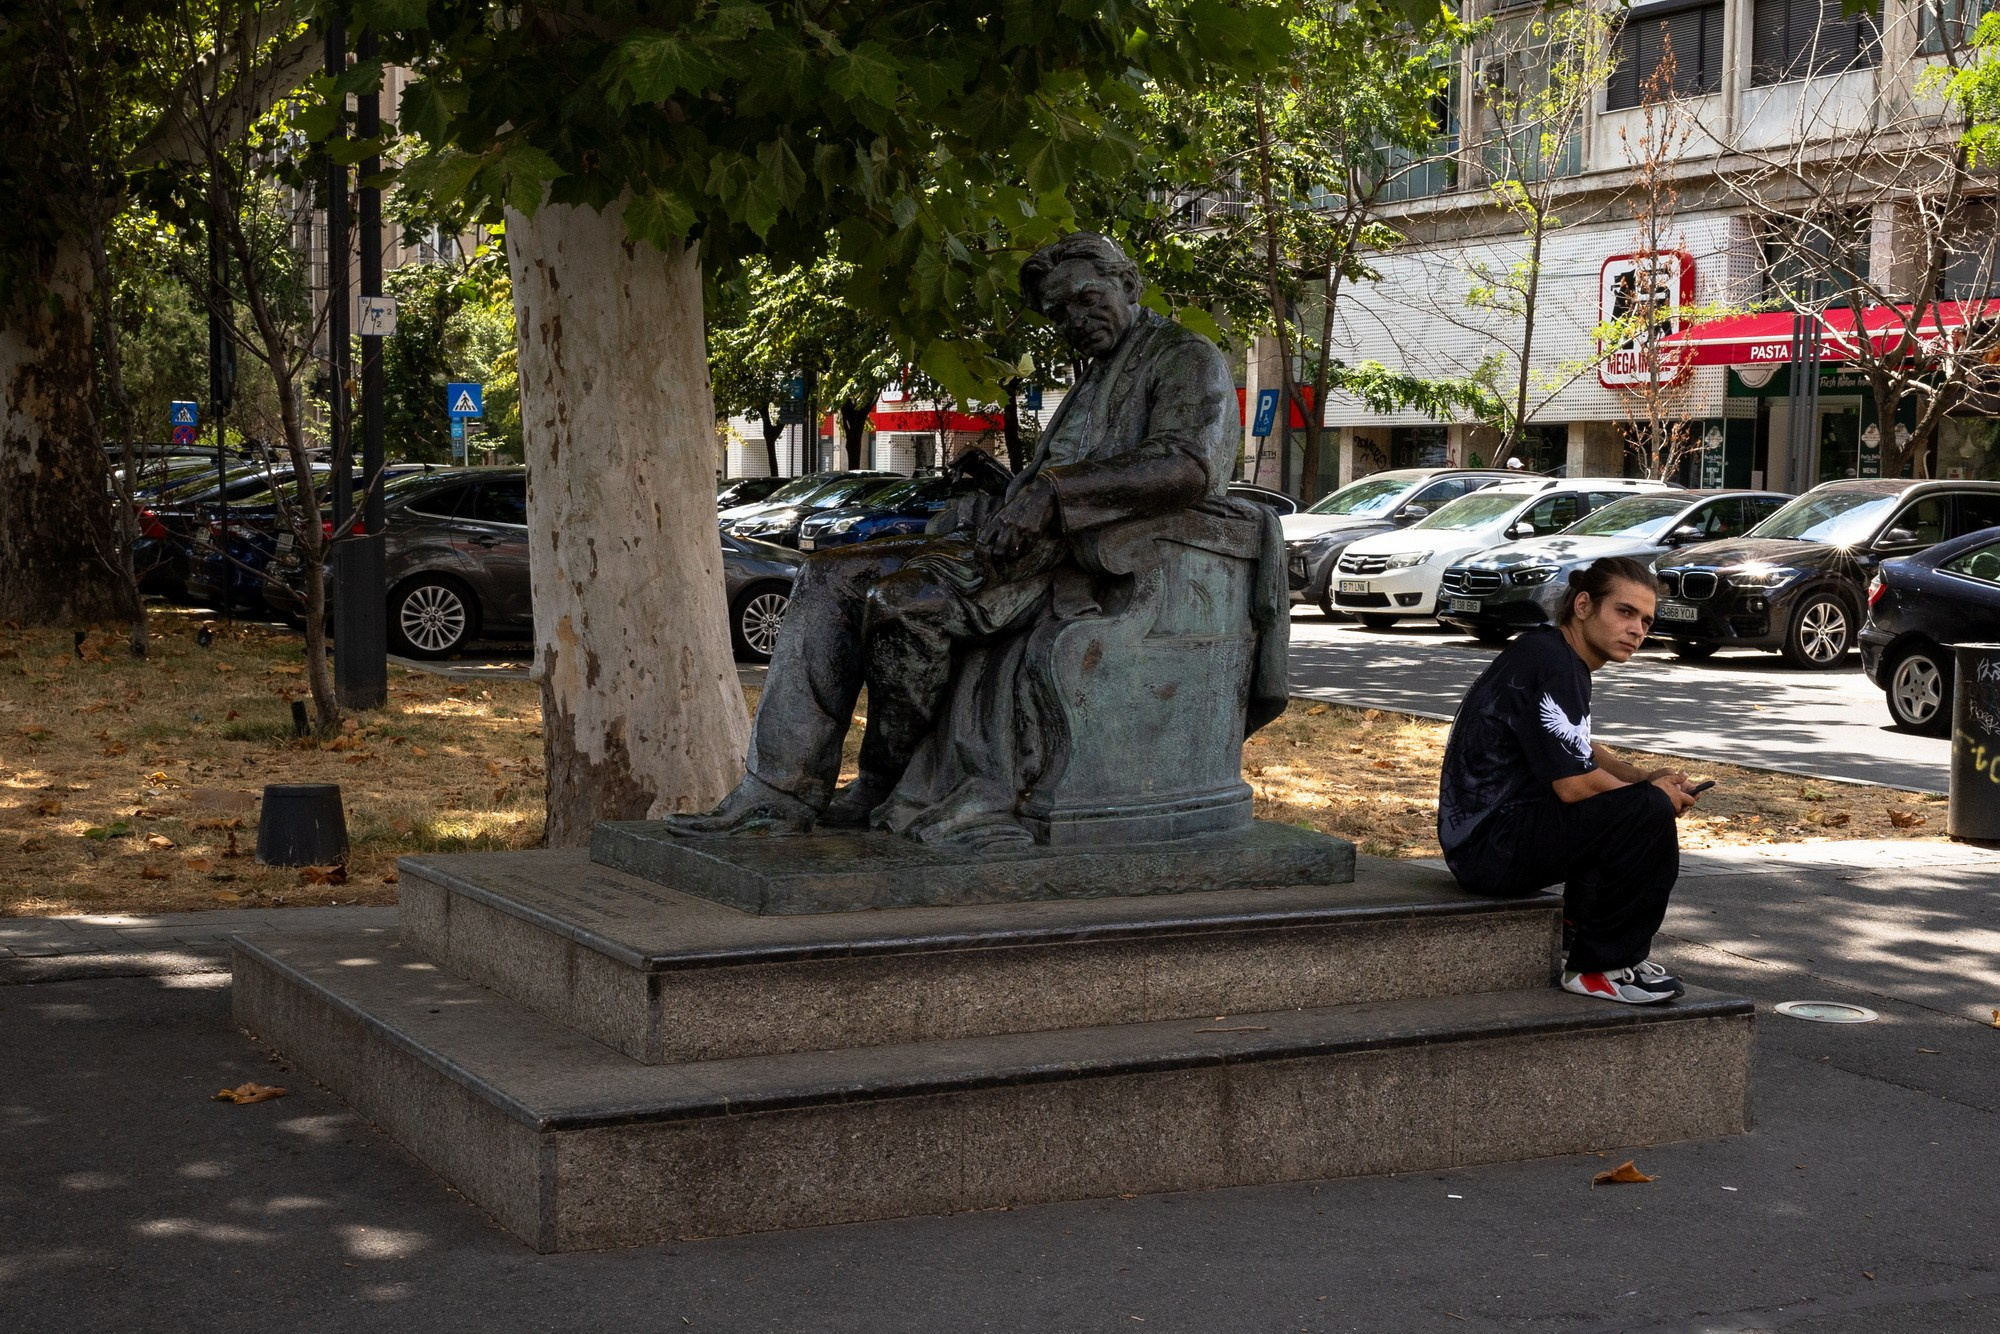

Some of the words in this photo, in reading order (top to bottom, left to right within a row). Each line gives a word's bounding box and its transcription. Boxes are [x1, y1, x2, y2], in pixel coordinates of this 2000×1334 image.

[387, 308, 393, 316] 2
[1750, 344, 1789, 360] PASTA
[1607, 352, 1637, 375] MEGA
[1259, 396, 1272, 421] P
[1680, 608, 1695, 619] YOA
